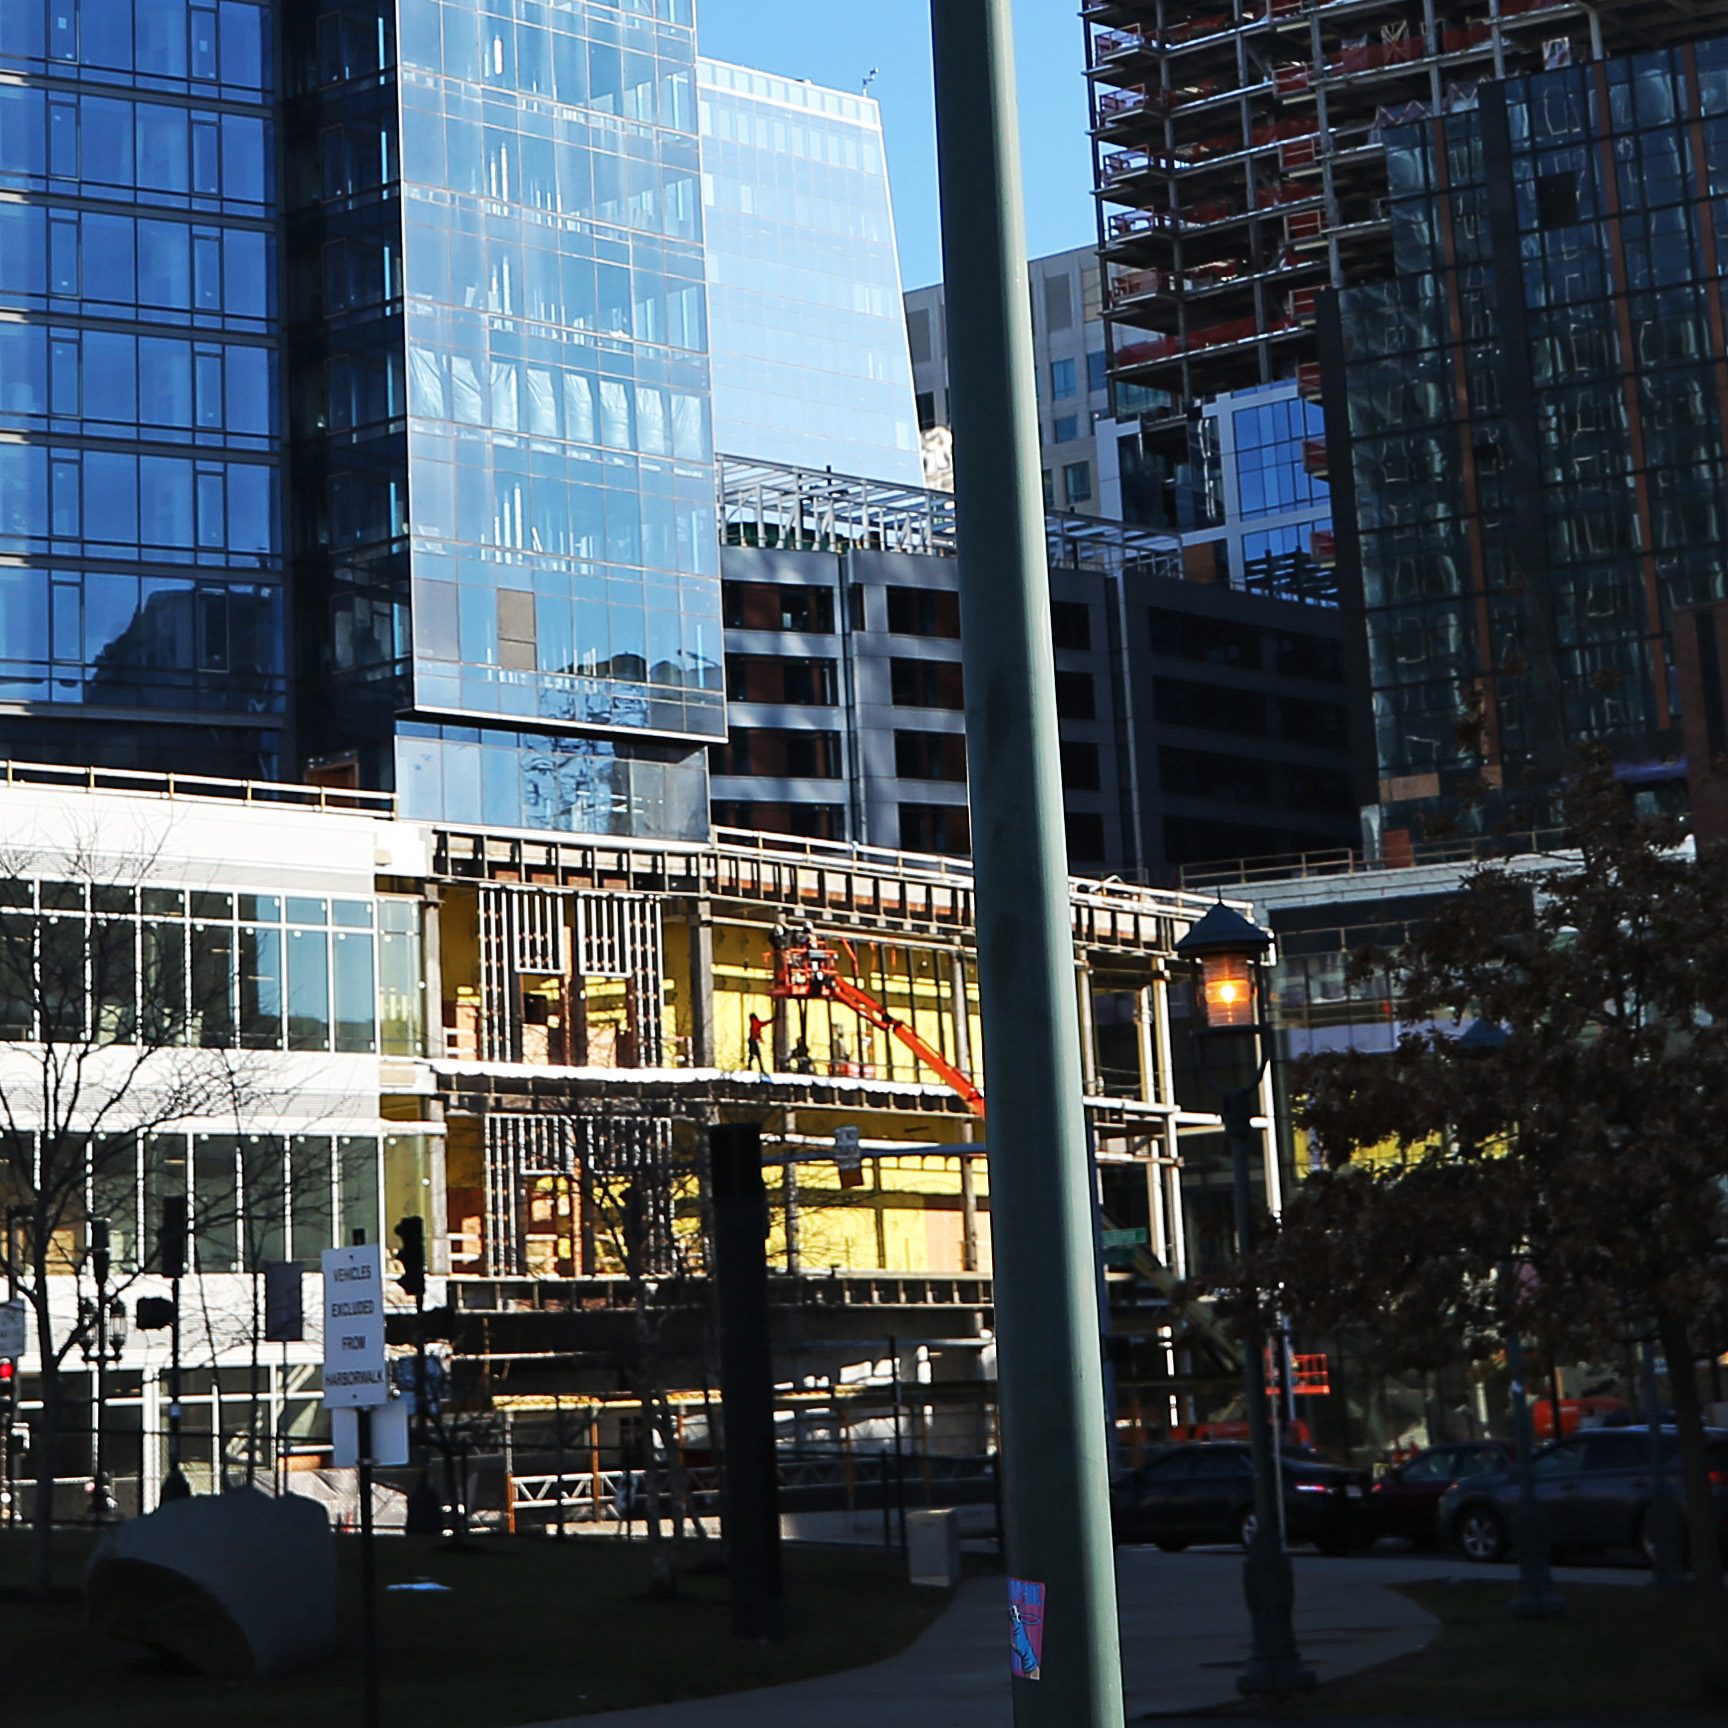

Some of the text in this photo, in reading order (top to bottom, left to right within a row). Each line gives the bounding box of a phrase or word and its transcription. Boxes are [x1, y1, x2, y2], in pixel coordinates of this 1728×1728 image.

[333, 1265, 372, 1282] VEHICLES
[331, 1299, 374, 1317] EXCLUDED
[342, 1335, 366, 1350] FROM
[325, 1369, 384, 1387] HARBORWALK
